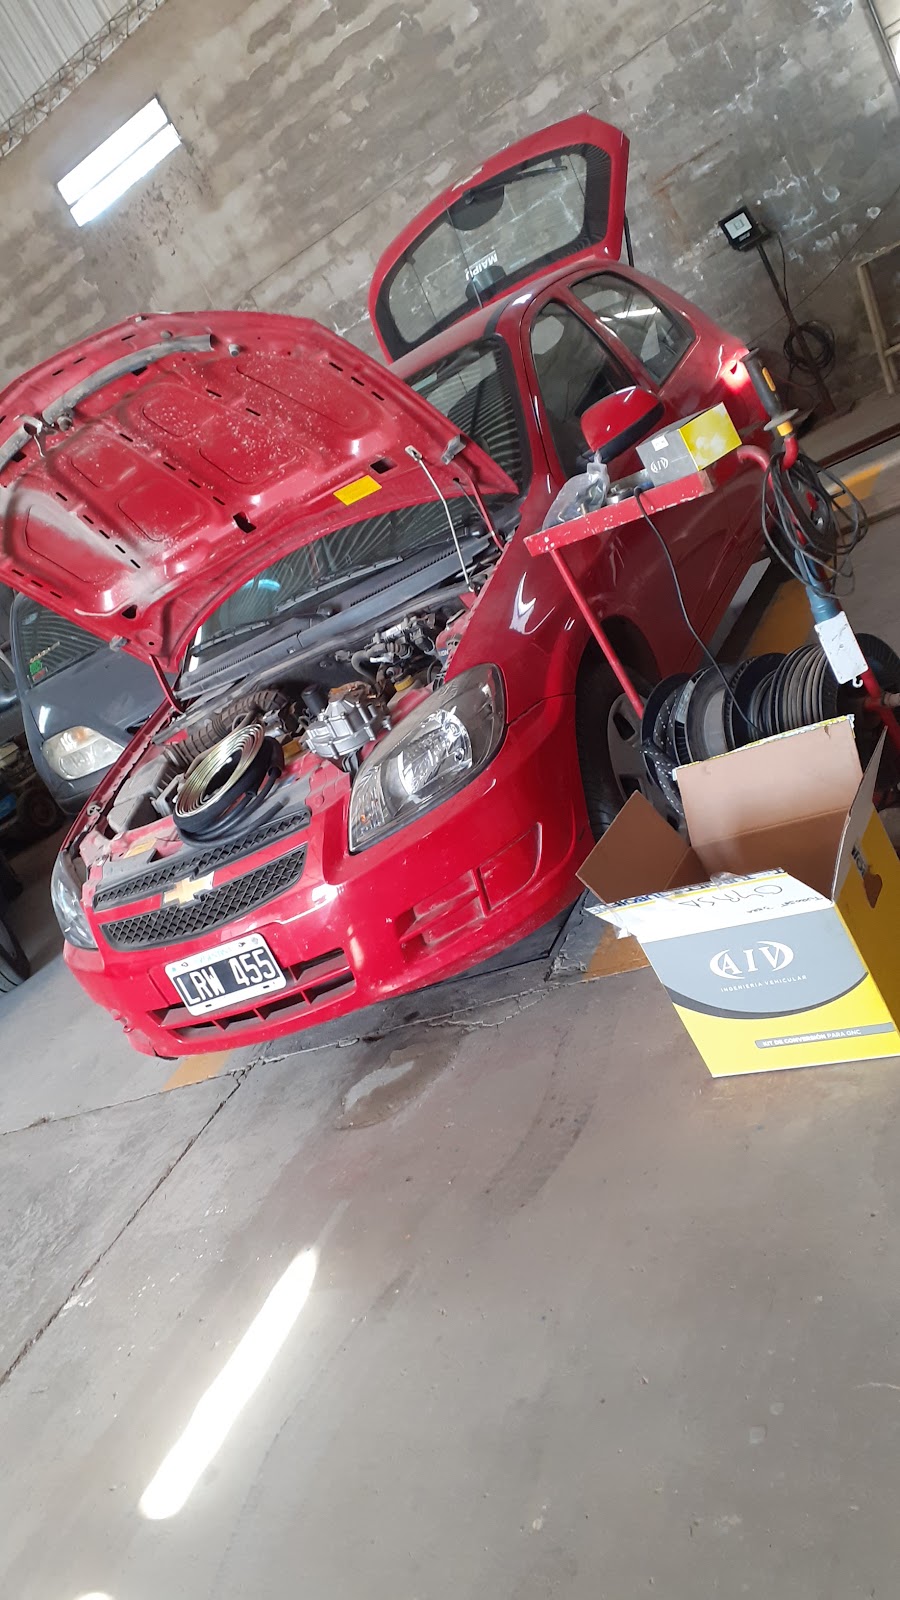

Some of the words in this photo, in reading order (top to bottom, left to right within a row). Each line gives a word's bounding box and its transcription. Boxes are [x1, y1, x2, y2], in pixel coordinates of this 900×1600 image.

[712, 942, 790, 978] AIV
[176, 965, 226, 1005] LRW
[228, 948, 276, 987] 455
[720, 983, 762, 992] INGENIERIA
[764, 975, 807, 985] VEHICULAR
[846, 1029, 861, 1037] GNC
